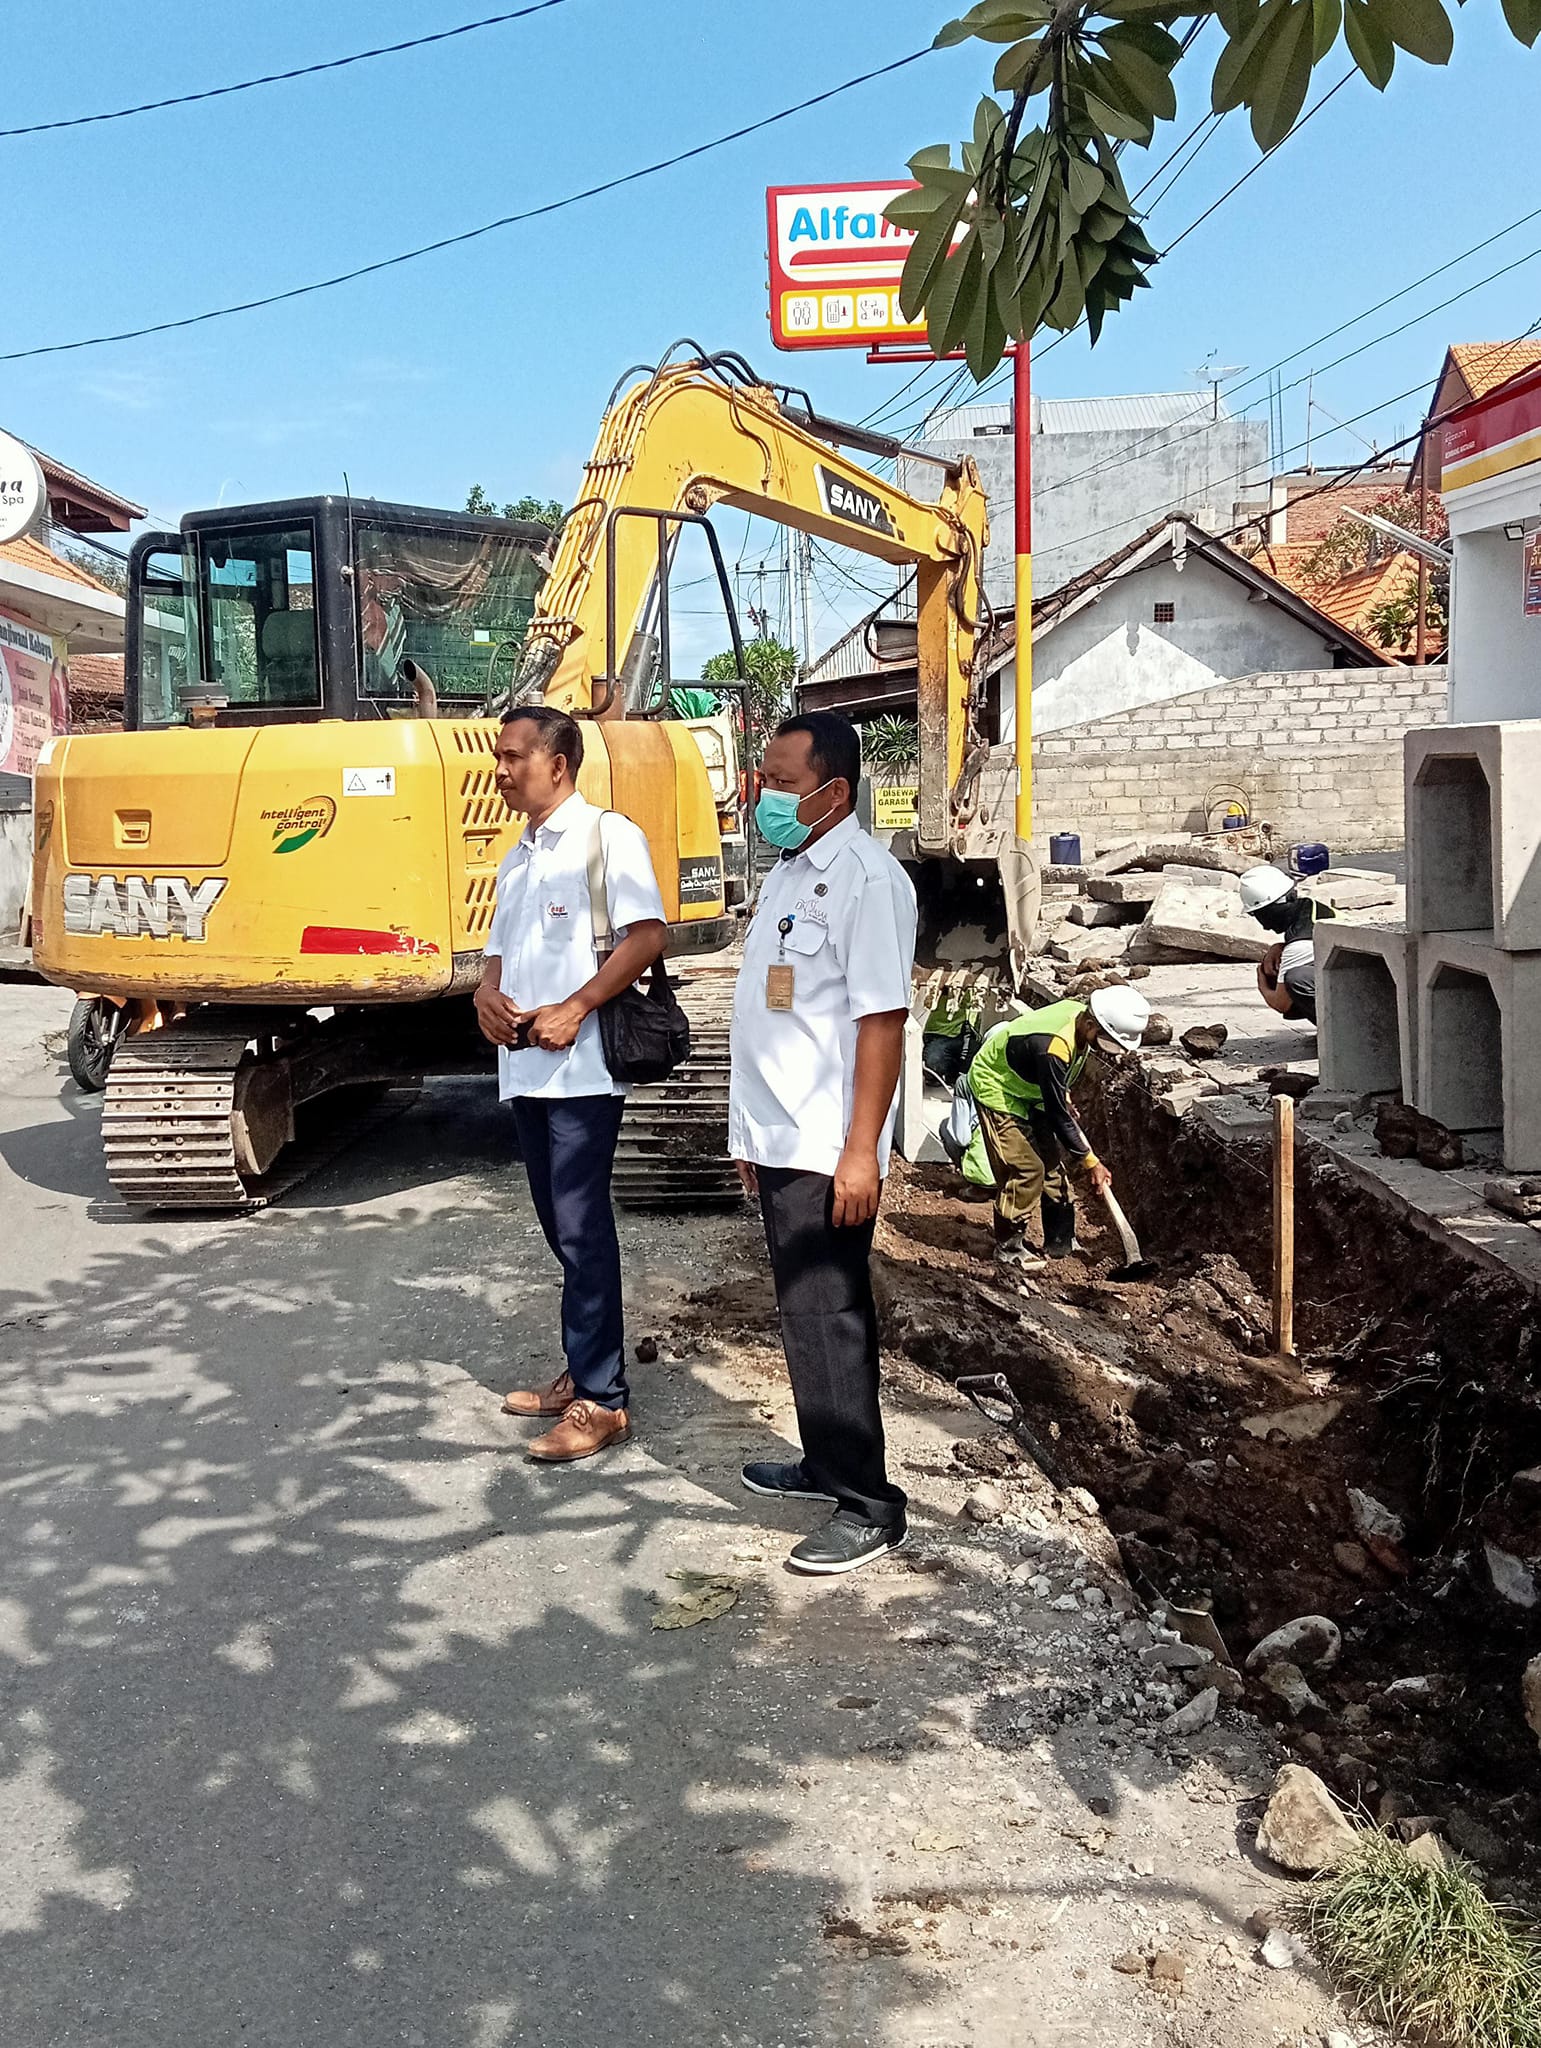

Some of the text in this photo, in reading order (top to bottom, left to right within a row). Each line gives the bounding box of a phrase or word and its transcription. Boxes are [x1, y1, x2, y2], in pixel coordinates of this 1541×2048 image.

[2, 495, 24, 506] Spa
[830, 483, 881, 525] SANY
[878, 798, 909, 806] GARASI
[260, 805, 326, 820] Intelligent
[691, 866, 717, 878] SANY
[63, 873, 230, 942] SANY
